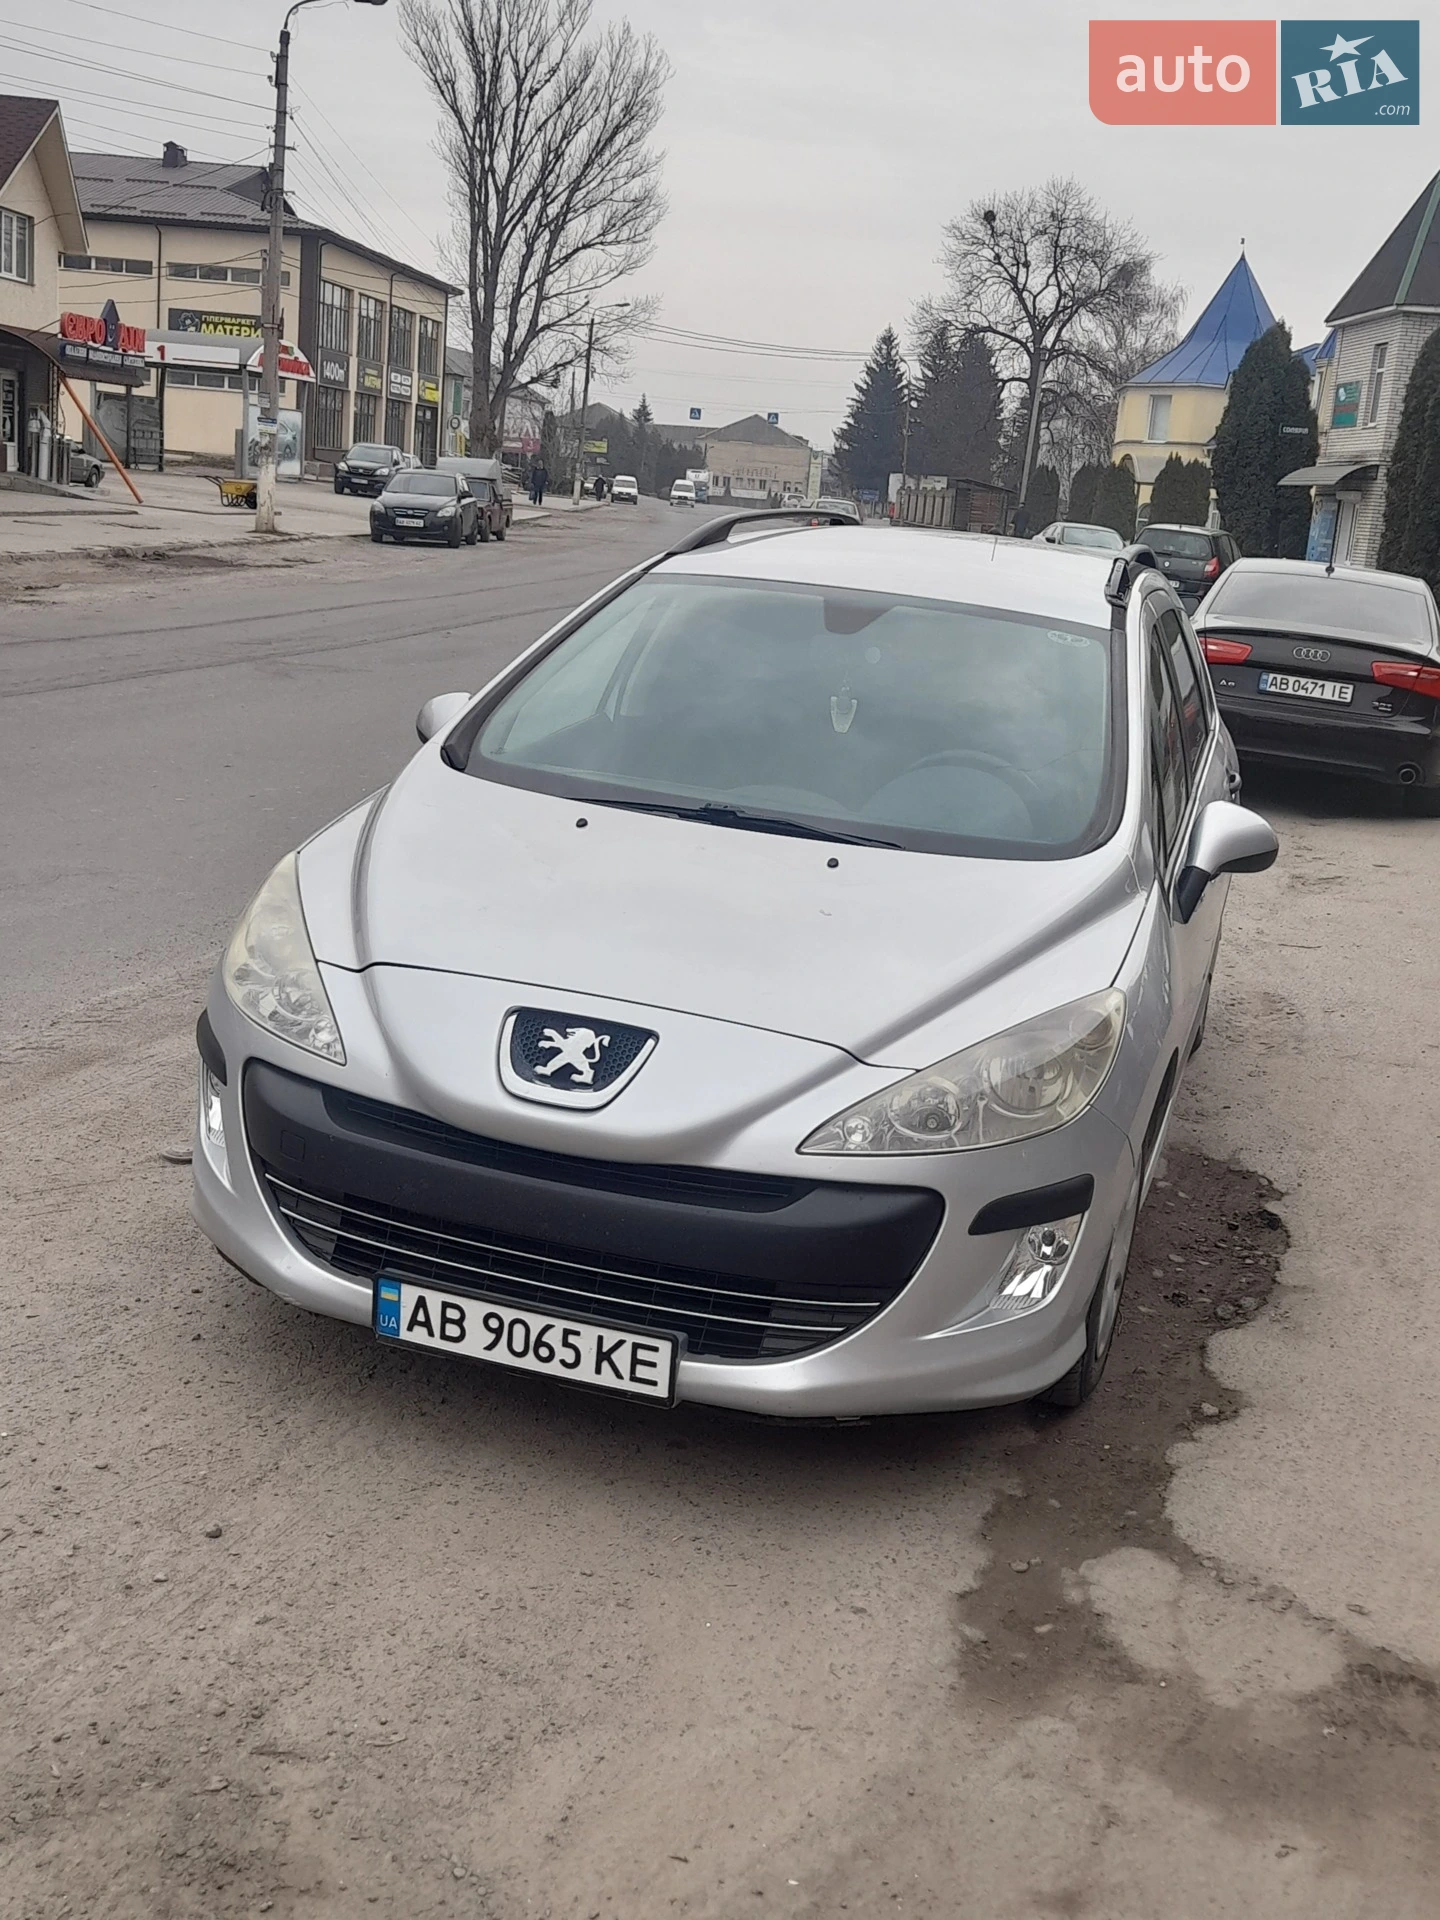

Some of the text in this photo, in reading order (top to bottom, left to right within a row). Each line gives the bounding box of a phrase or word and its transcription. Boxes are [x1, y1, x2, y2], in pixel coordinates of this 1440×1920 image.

[202, 314, 257, 326] ГІПЕРМАРКЕТ
[1268, 676, 1289, 691] AB
[1292, 679, 1326, 696] 0471
[1331, 684, 1350, 700] IE
[380, 1313, 399, 1330] UA
[406, 1295, 661, 1387] AB 9065 KE
